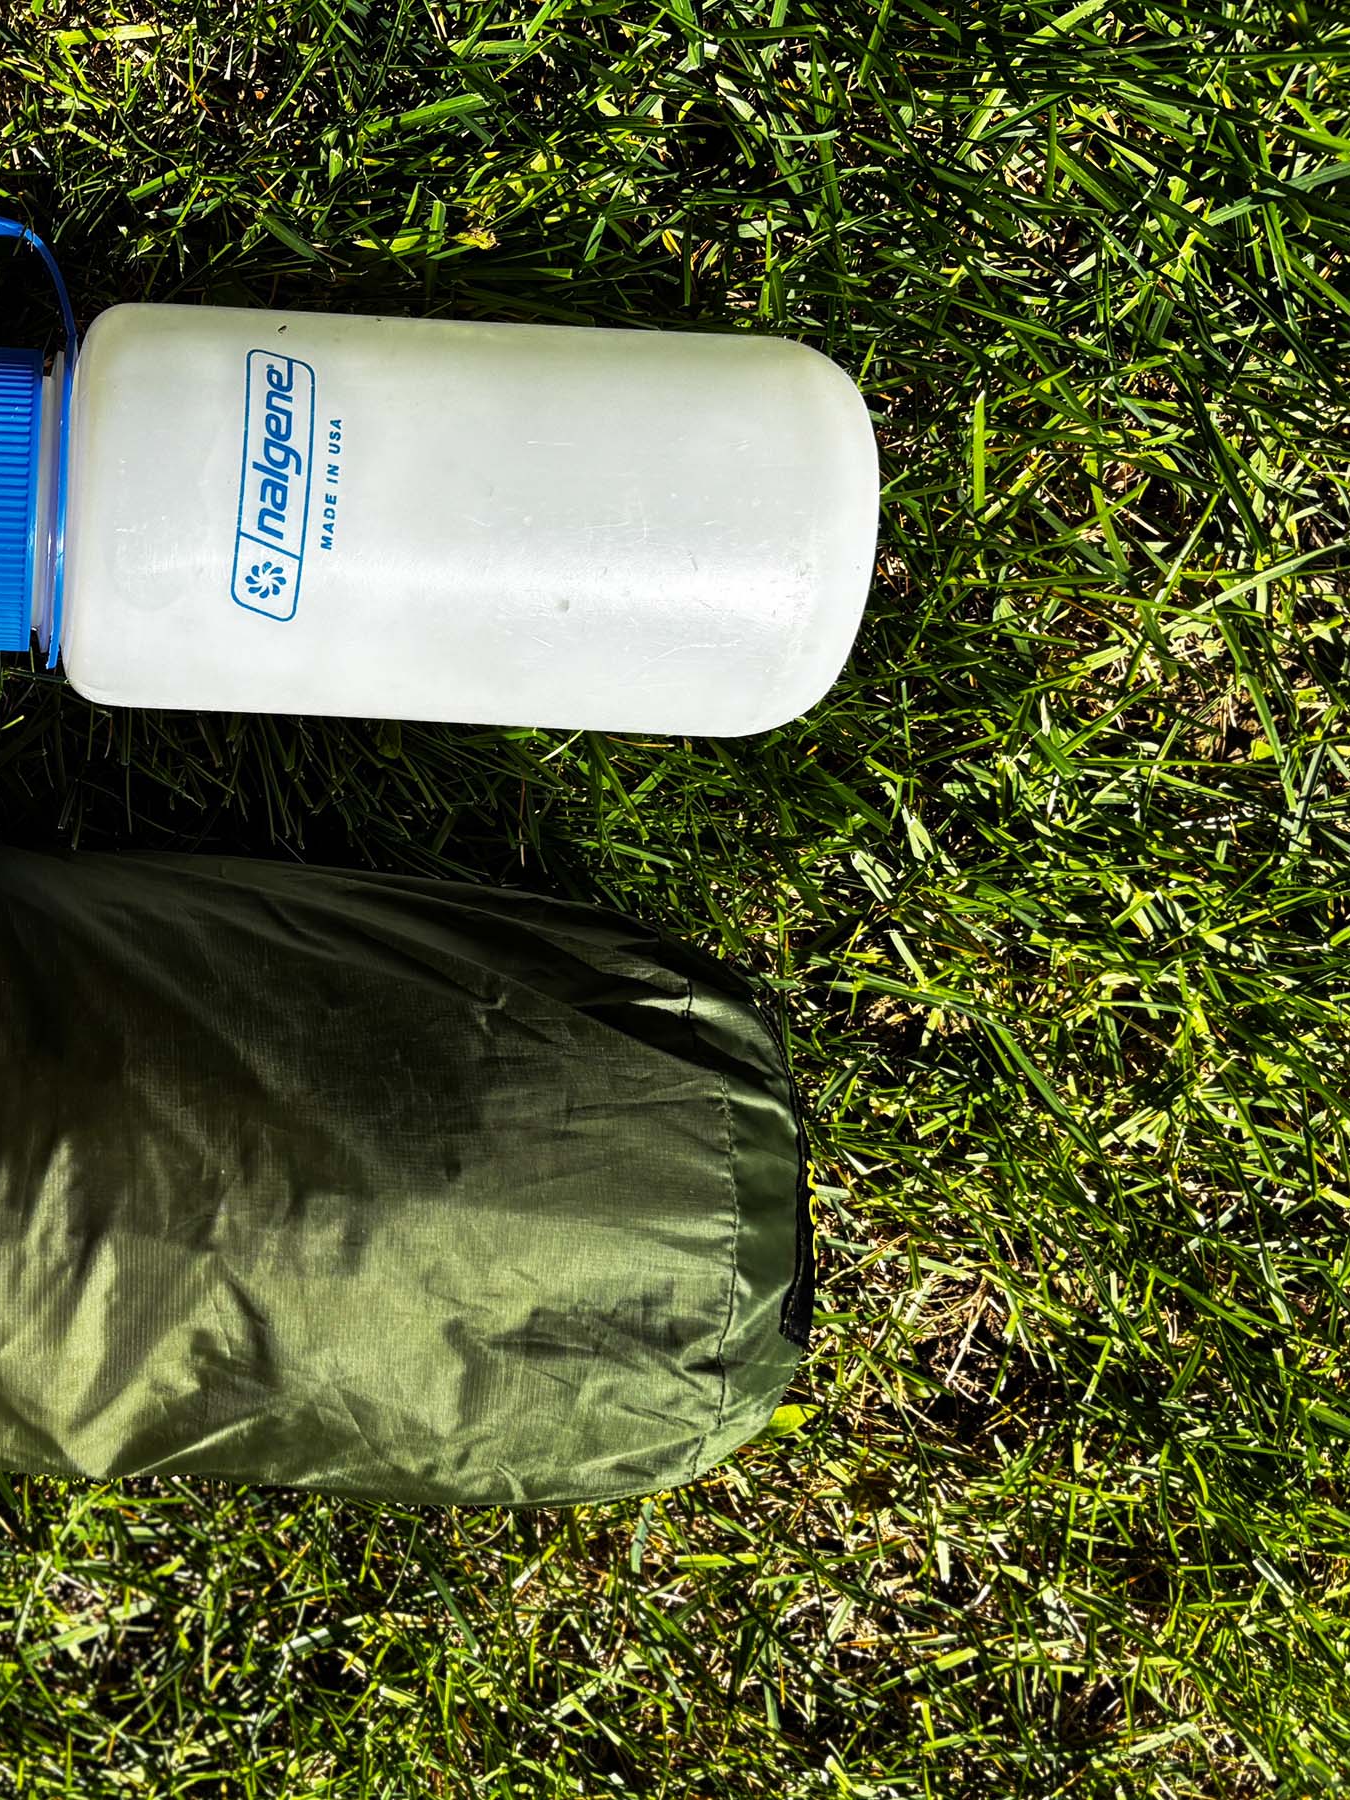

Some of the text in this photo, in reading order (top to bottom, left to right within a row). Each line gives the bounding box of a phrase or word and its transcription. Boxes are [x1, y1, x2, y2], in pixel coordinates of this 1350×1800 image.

[320, 419, 342, 550] MADE IN USA
